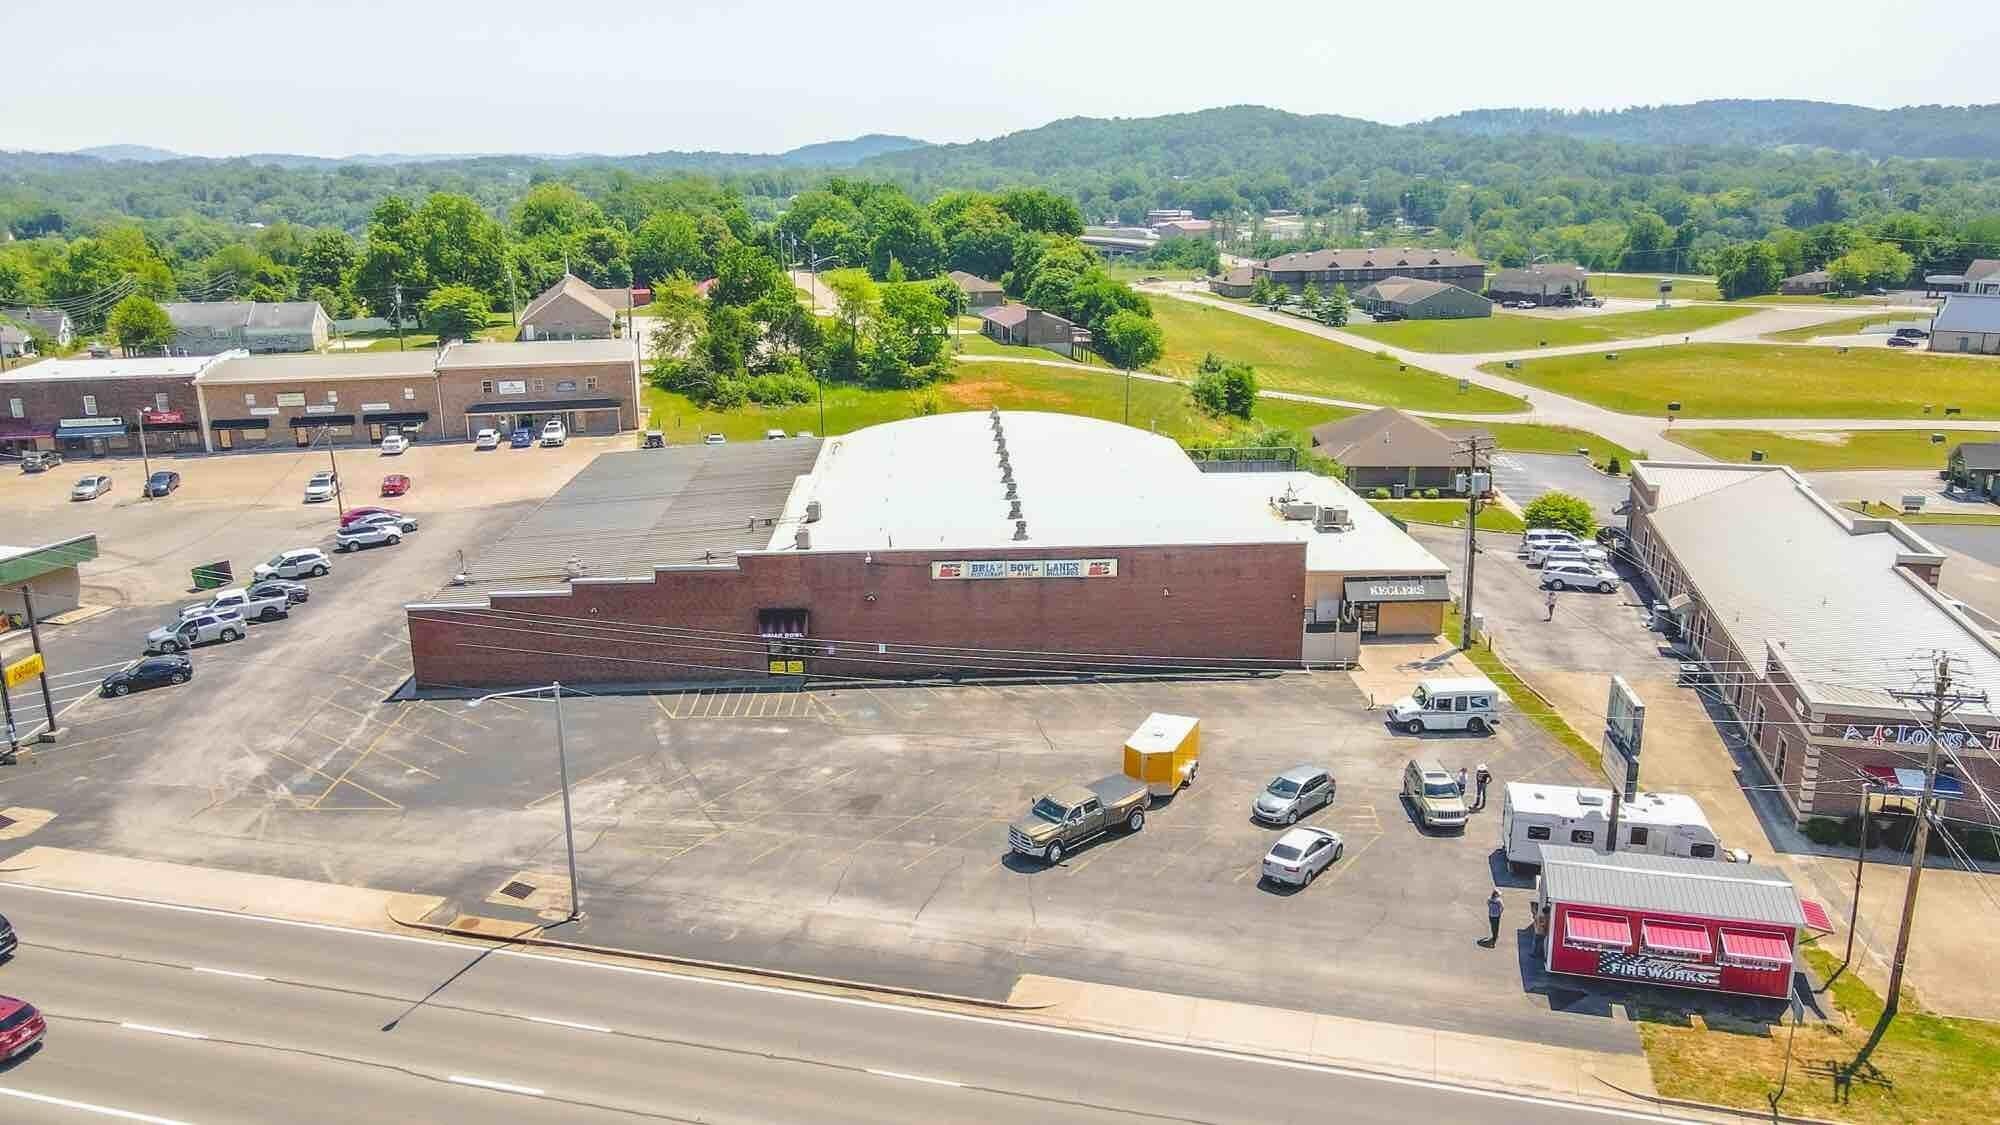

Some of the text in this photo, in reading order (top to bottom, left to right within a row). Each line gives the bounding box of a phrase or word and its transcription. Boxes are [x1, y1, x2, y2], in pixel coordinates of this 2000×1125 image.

[1010, 563, 1039, 572] BOWL
[1046, 562, 1080, 571] LANES
[1611, 962, 1709, 983] FIREWORKS
